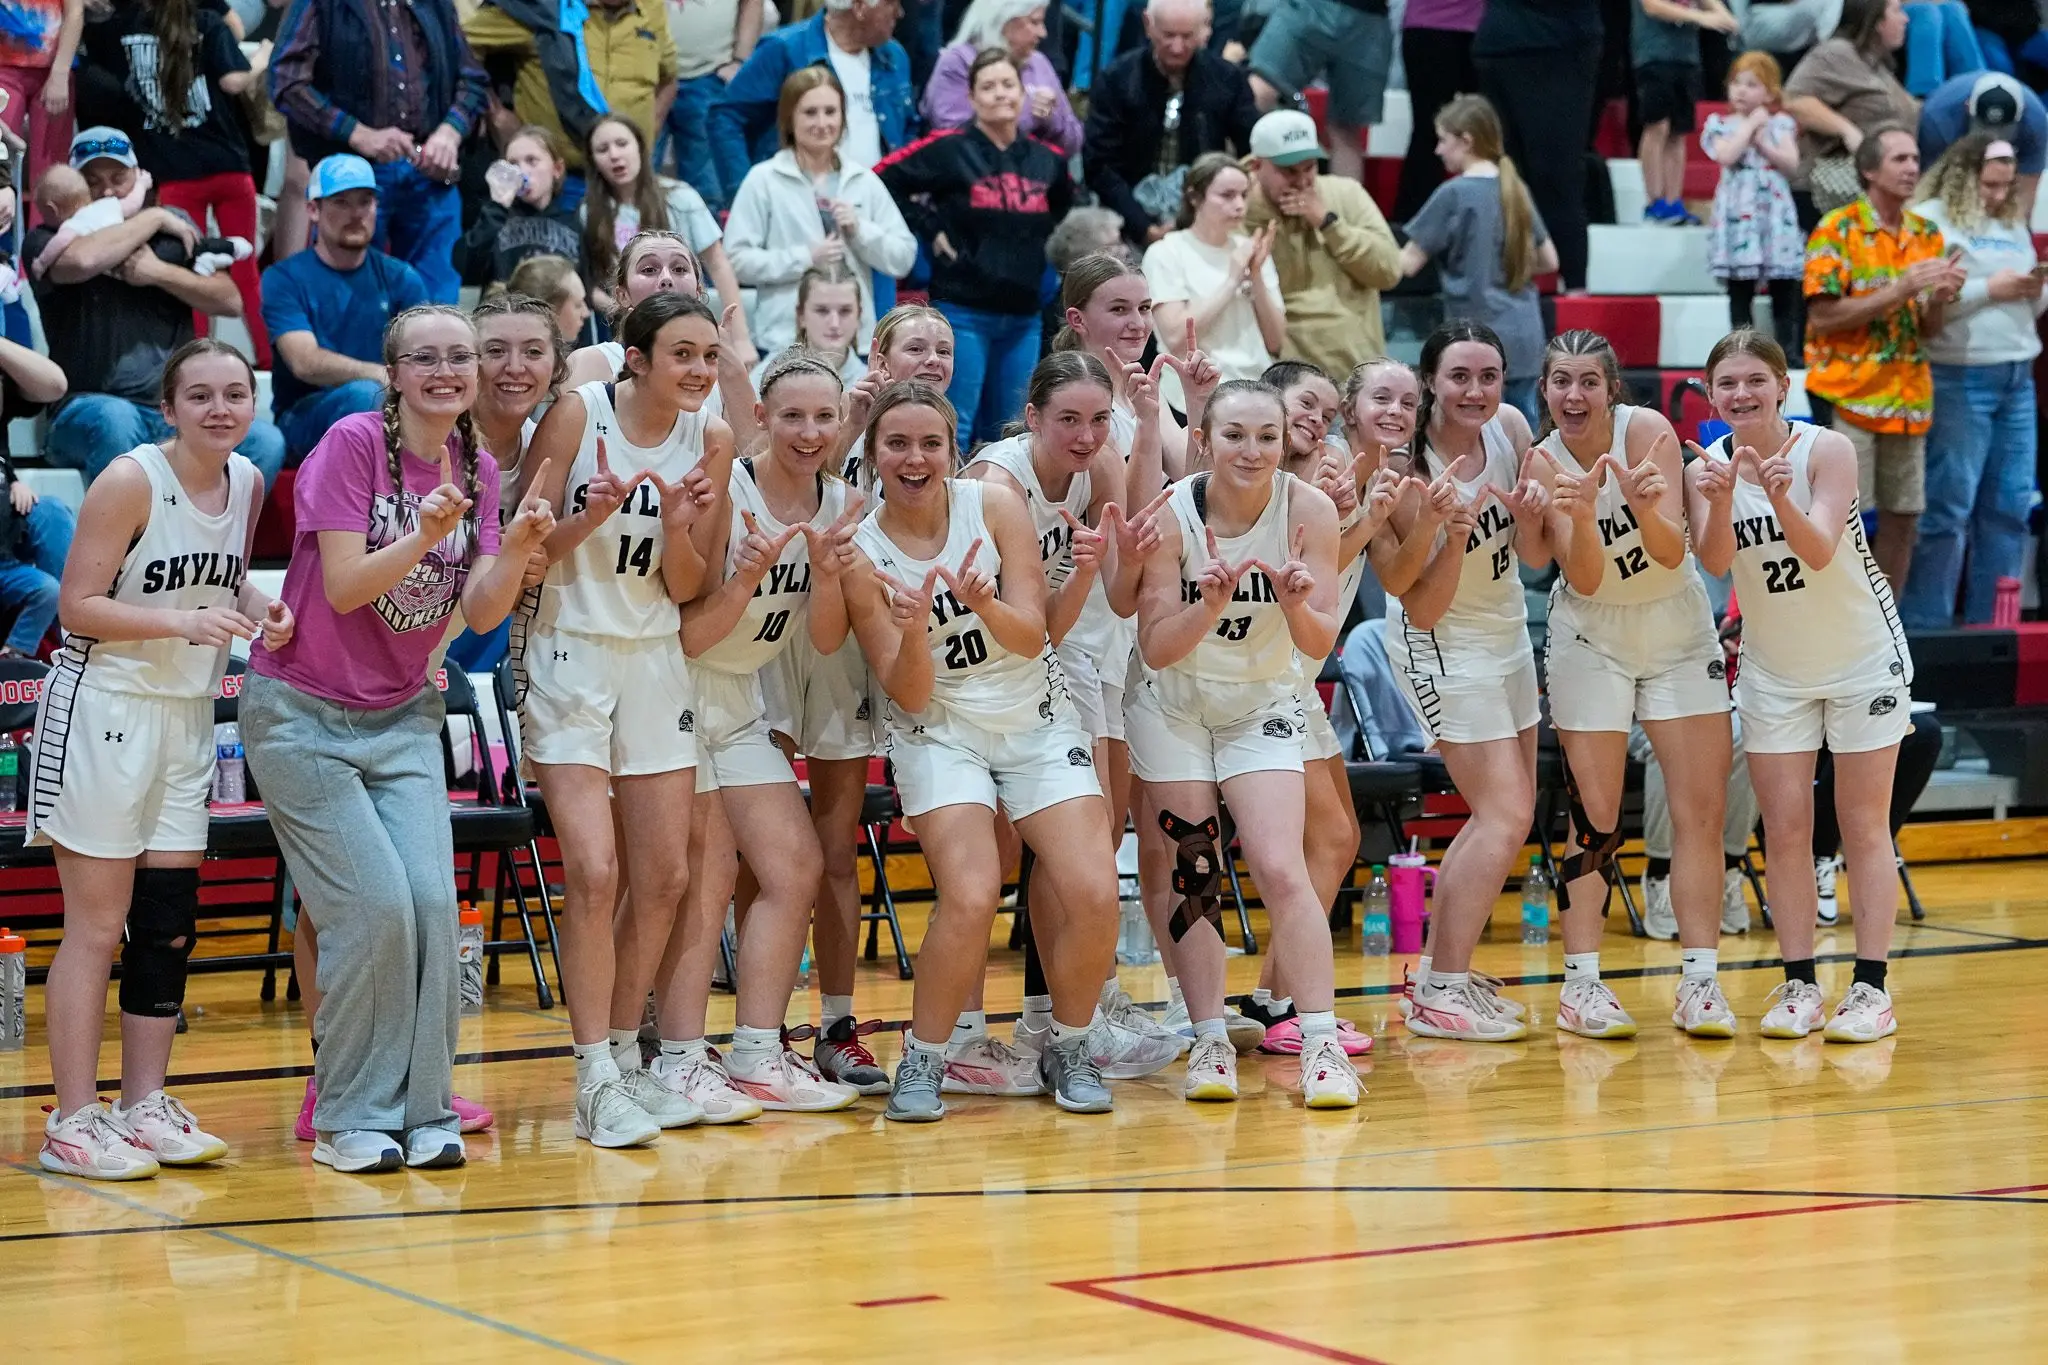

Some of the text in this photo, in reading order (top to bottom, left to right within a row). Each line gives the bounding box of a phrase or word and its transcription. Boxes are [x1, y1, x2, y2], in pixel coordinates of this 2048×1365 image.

[616, 534, 654, 576] 14
[1492, 544, 1509, 580] 15
[1614, 546, 1649, 580] 12
[1762, 557, 1805, 593] 22
[373, 594, 455, 632] URNAMENT
[752, 610, 790, 642] 10
[1216, 616, 1252, 641] 13
[945, 629, 988, 669] 20
